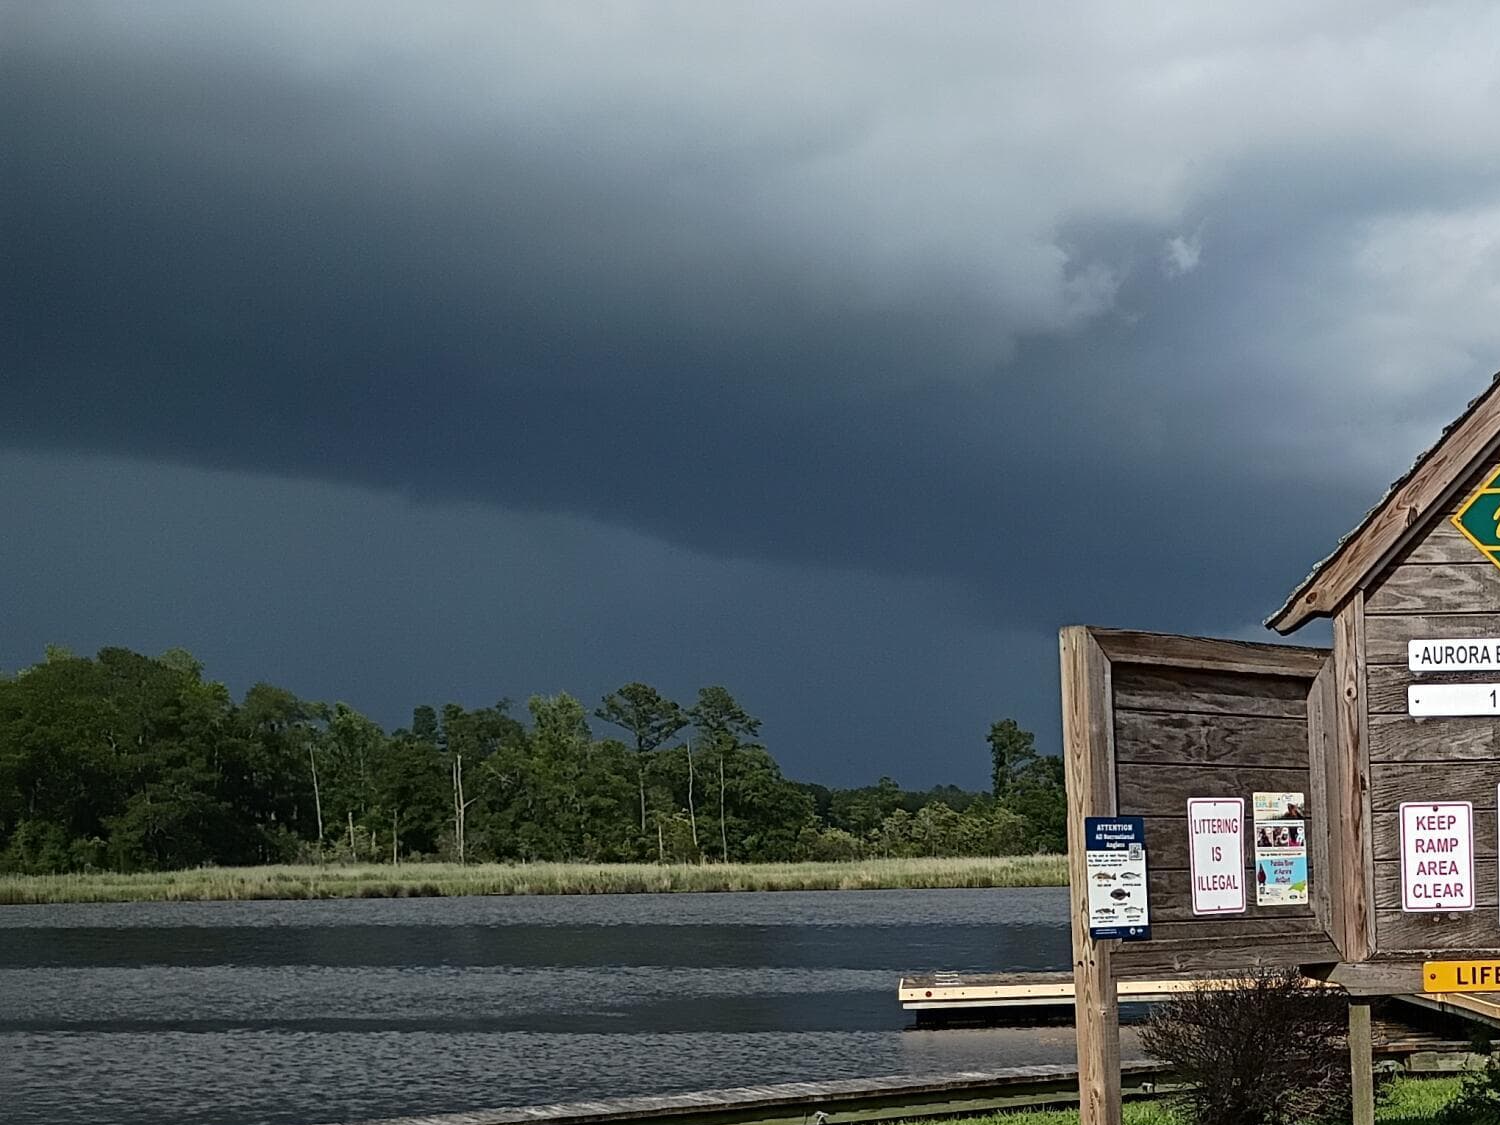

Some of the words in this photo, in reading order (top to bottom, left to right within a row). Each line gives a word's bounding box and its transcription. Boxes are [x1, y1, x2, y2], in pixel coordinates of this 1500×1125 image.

[1421, 645, 1490, 664] AURORA
[1490, 690, 1496, 708] 1
[1194, 819, 1238, 834] LITTERING
[1416, 816, 1456, 830] KEEP
[1415, 838, 1458, 853] RAMP
[1211, 847, 1222, 861] IS
[1417, 861, 1459, 875] AREA
[1198, 875, 1238, 891] ILLEGAL
[1413, 883, 1464, 898] CLEAR
